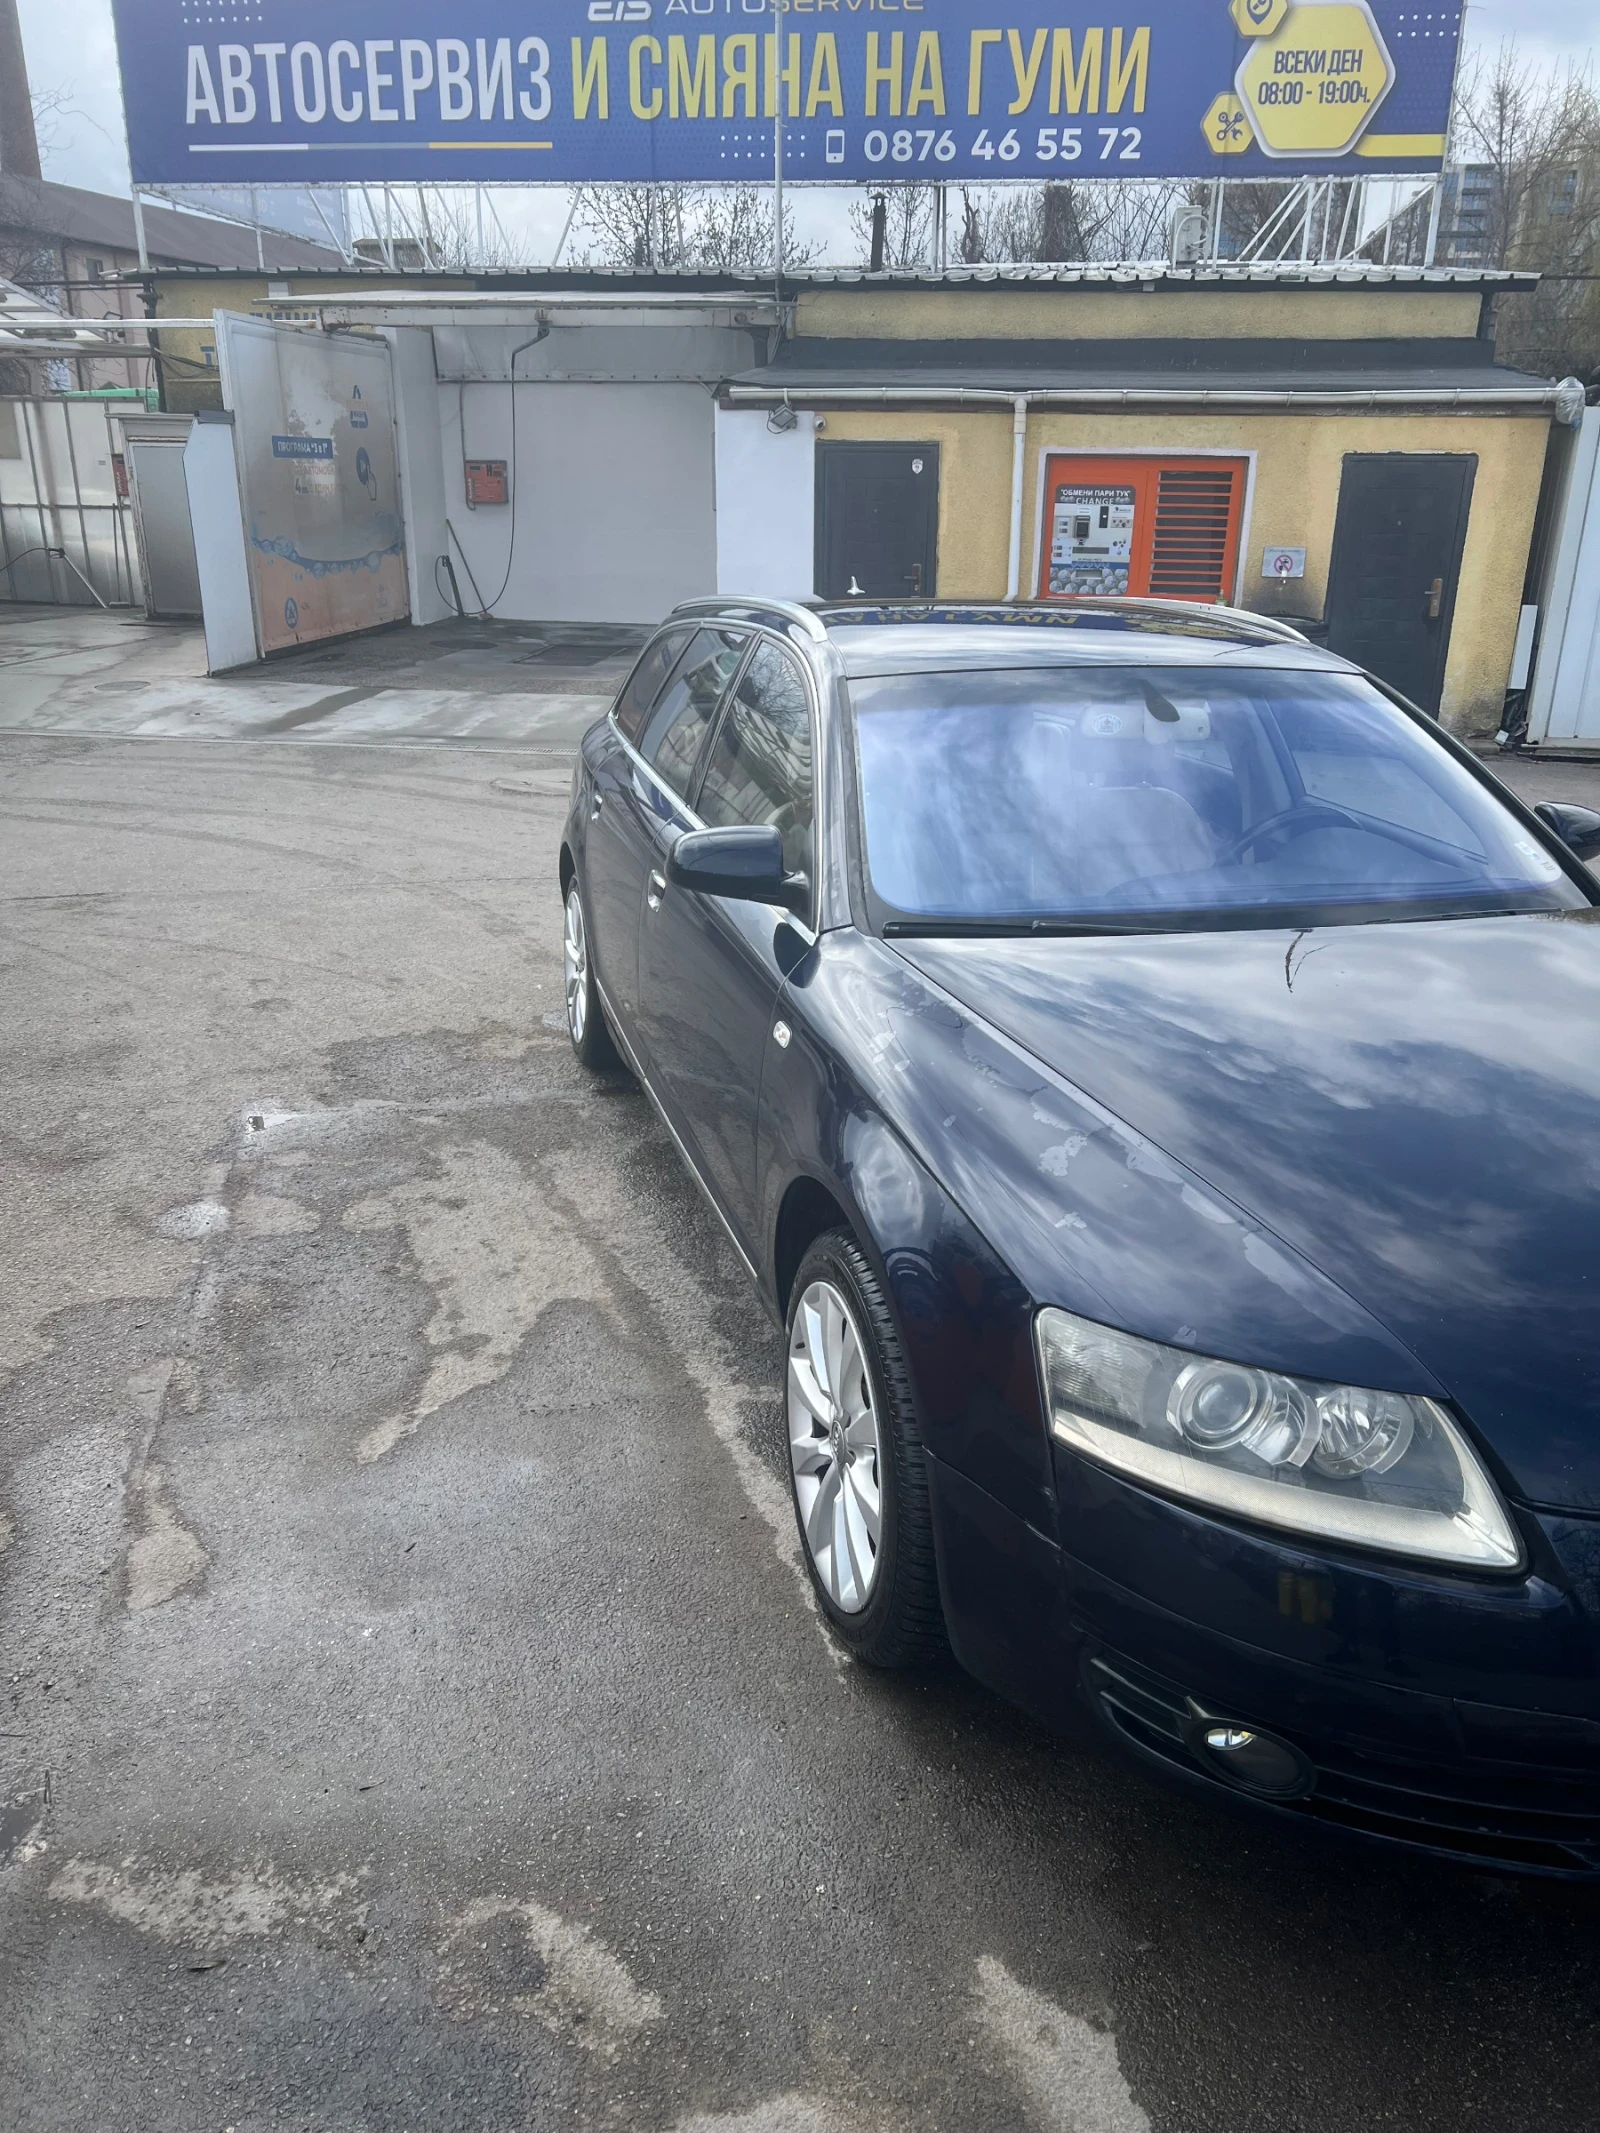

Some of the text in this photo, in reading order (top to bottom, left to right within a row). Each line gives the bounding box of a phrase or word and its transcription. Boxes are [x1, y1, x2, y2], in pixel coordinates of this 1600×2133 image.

[186, 27, 1152, 125] АВТОСЕРВИЗ И СМЯНА НА ГУМИ
[1274, 49, 1363, 76] ВСЕКИ ДЕН
[1258, 81, 1303, 105] 08:00
[1318, 80, 1371, 104] 19:00ч.
[863, 127, 1142, 163] 0876 46 55 72
[1076, 497, 1114, 505] CHANGE
